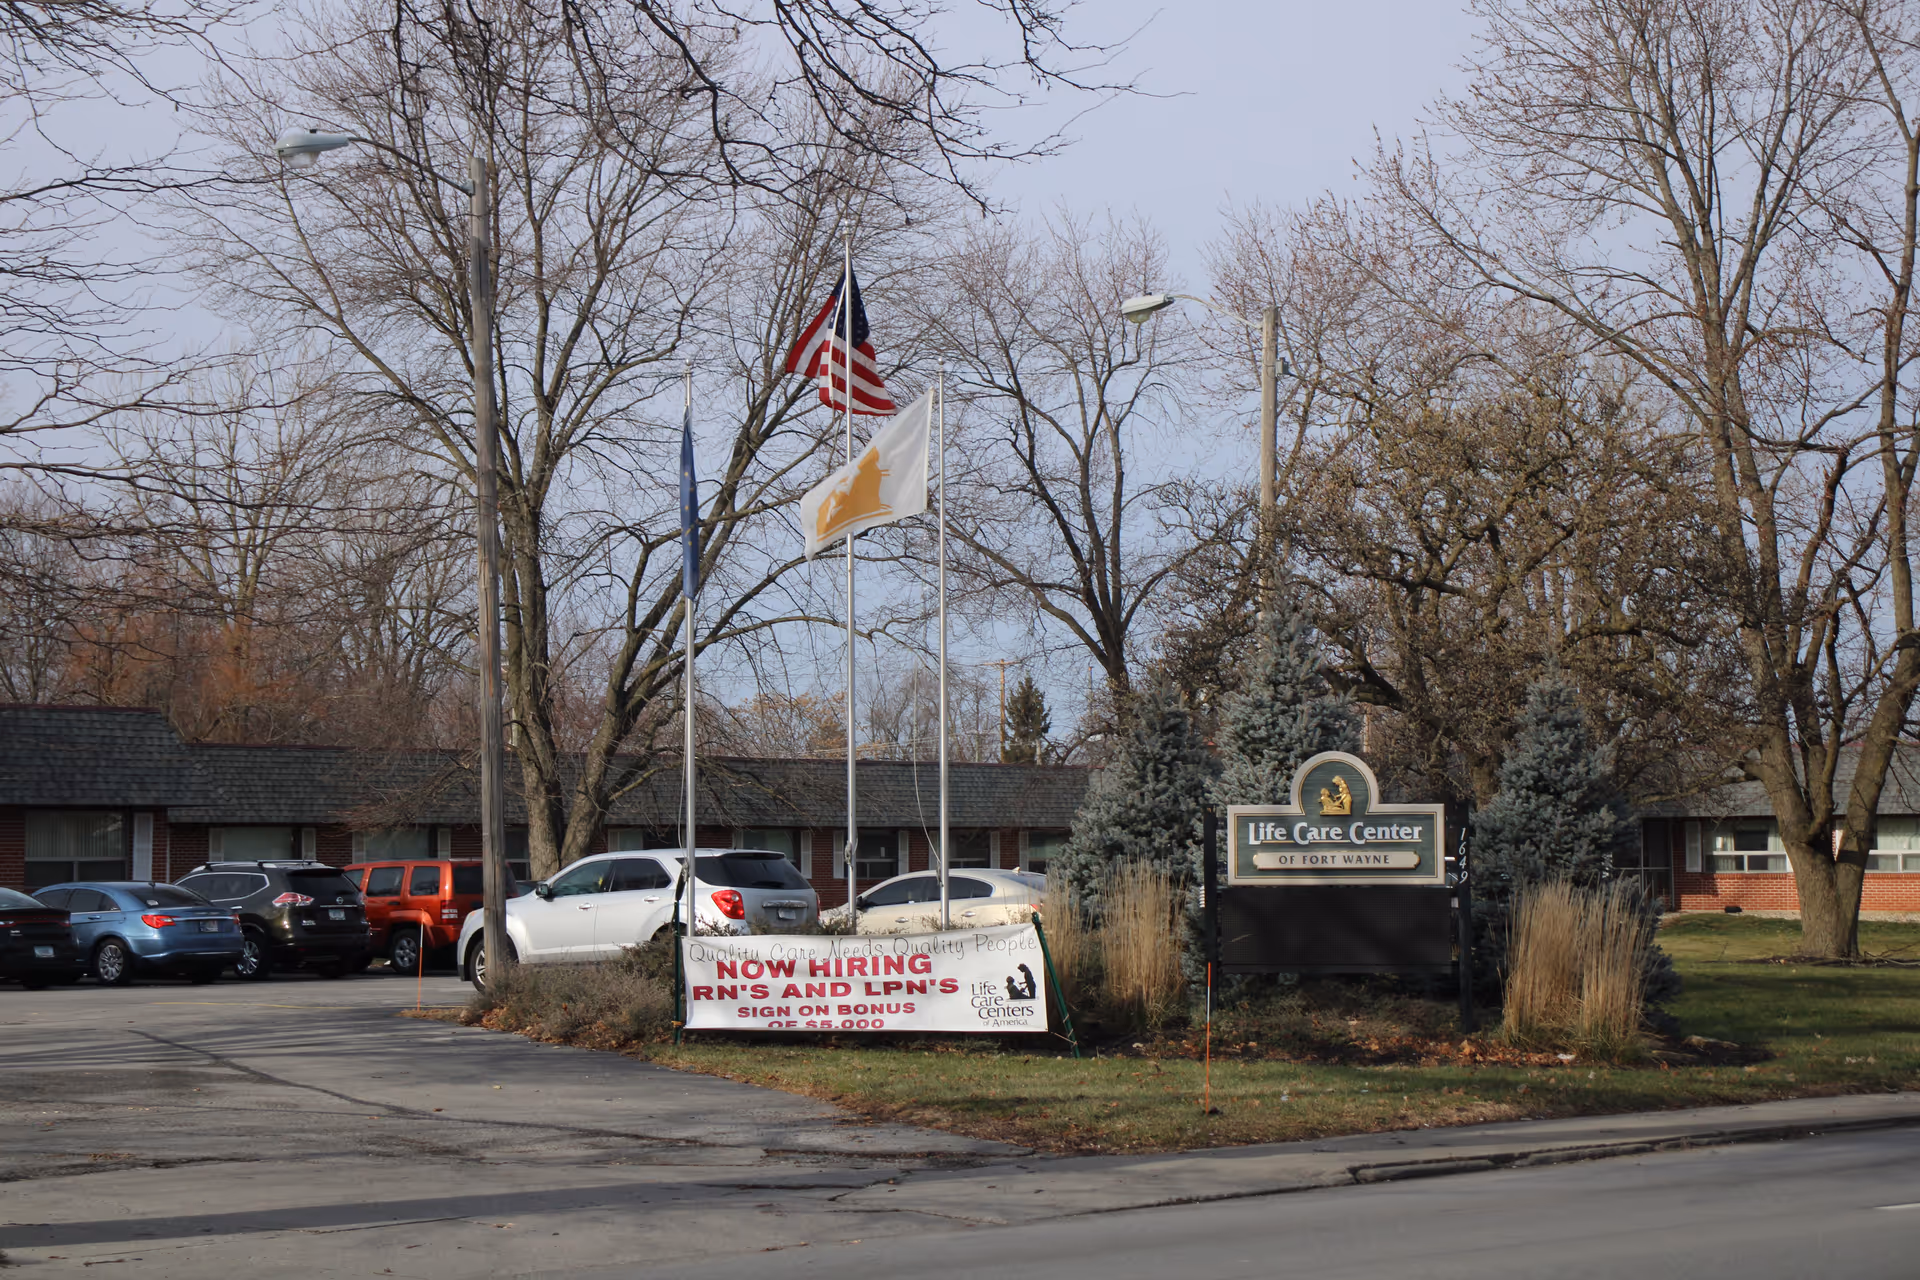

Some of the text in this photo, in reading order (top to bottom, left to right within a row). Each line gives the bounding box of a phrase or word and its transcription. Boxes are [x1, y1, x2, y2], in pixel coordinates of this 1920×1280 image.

[1249, 822, 1422, 845] Life Care Center
[1278, 854, 1390, 865] OF FORT WAYNE
[1459, 827, 1468, 884] 1649
[689, 930, 1037, 967] Quality Care Needs Quality People
[716, 953, 932, 980] NOW HIRING
[692, 977, 960, 1001] RN'S AND LPN'S
[971, 981, 997, 996] Life
[737, 1002, 916, 1019] SIGN ON BONUS
[768, 1020, 798, 1029] OF
[992, 1017, 1028, 1028] America
